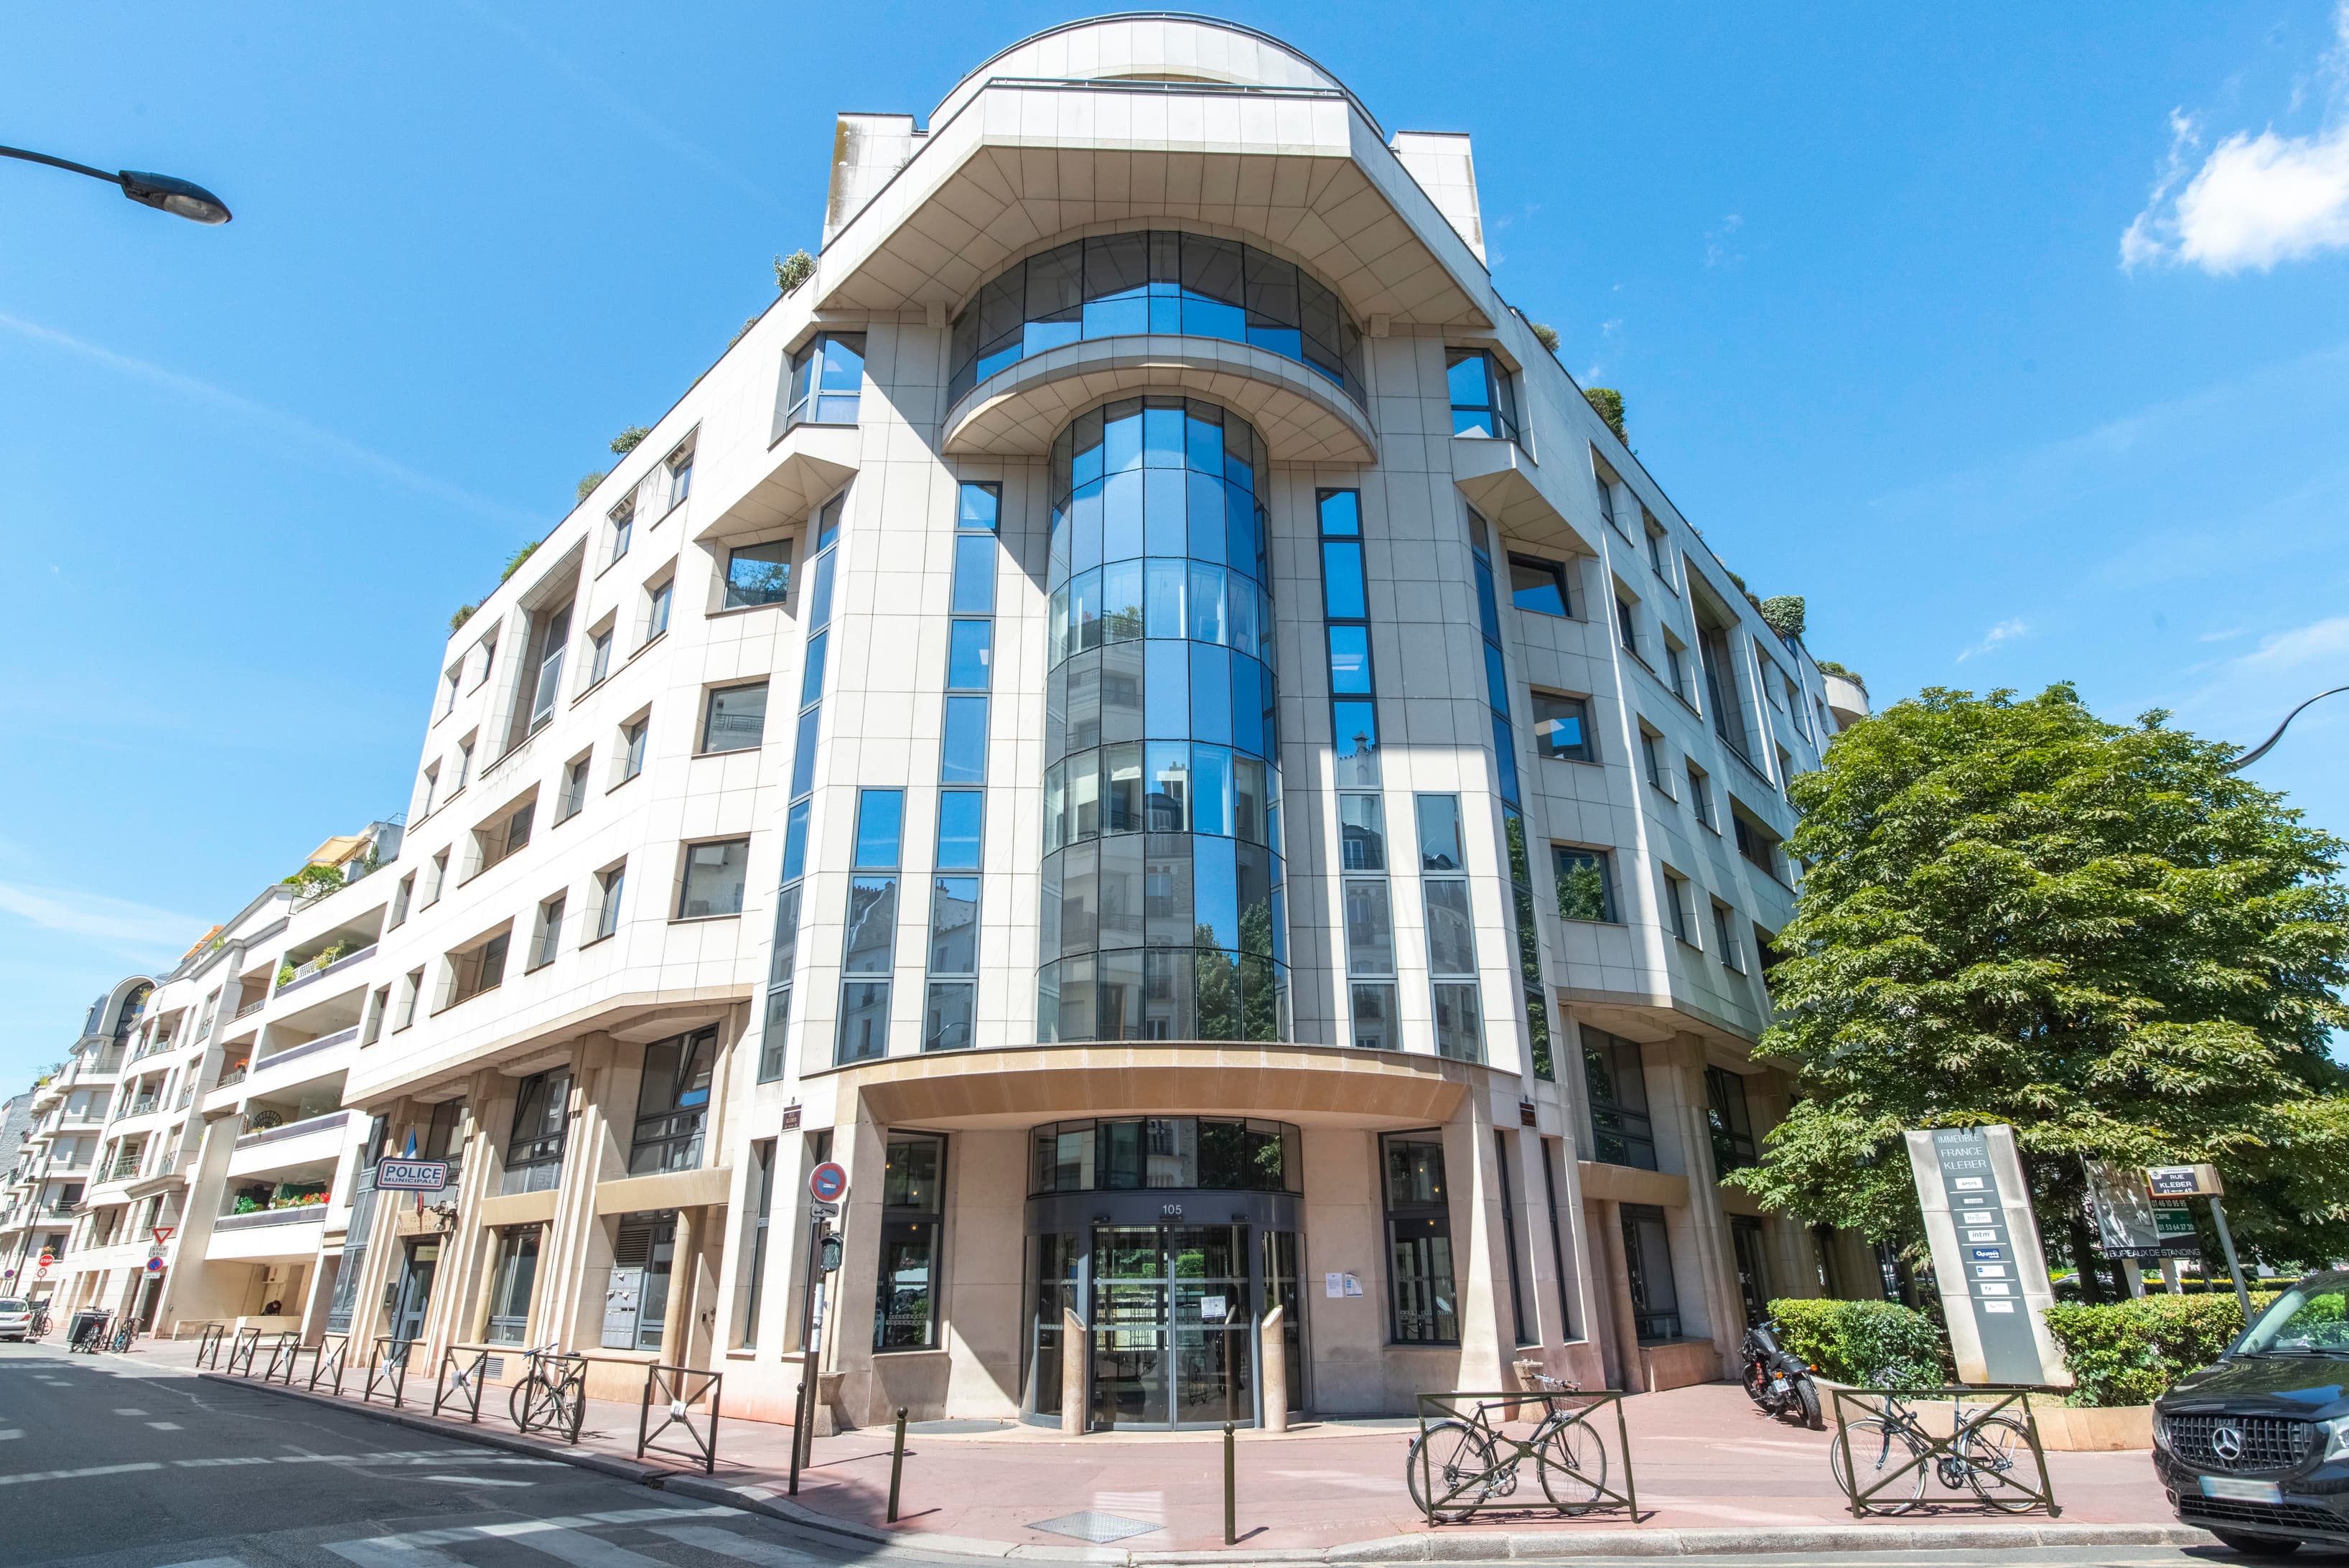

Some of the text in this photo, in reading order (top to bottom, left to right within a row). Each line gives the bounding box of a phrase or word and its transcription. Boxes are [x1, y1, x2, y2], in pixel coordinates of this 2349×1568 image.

[1937, 1133, 1981, 1144] IMMEUBLE
[1941, 1147, 1984, 1157] FRANCE
[1943, 1159, 1987, 1170] KLEBER
[386, 1166, 442, 1179] POLICE
[1162, 1204, 1182, 1215] 105
[2161, 1248, 2200, 1256] STANDING
